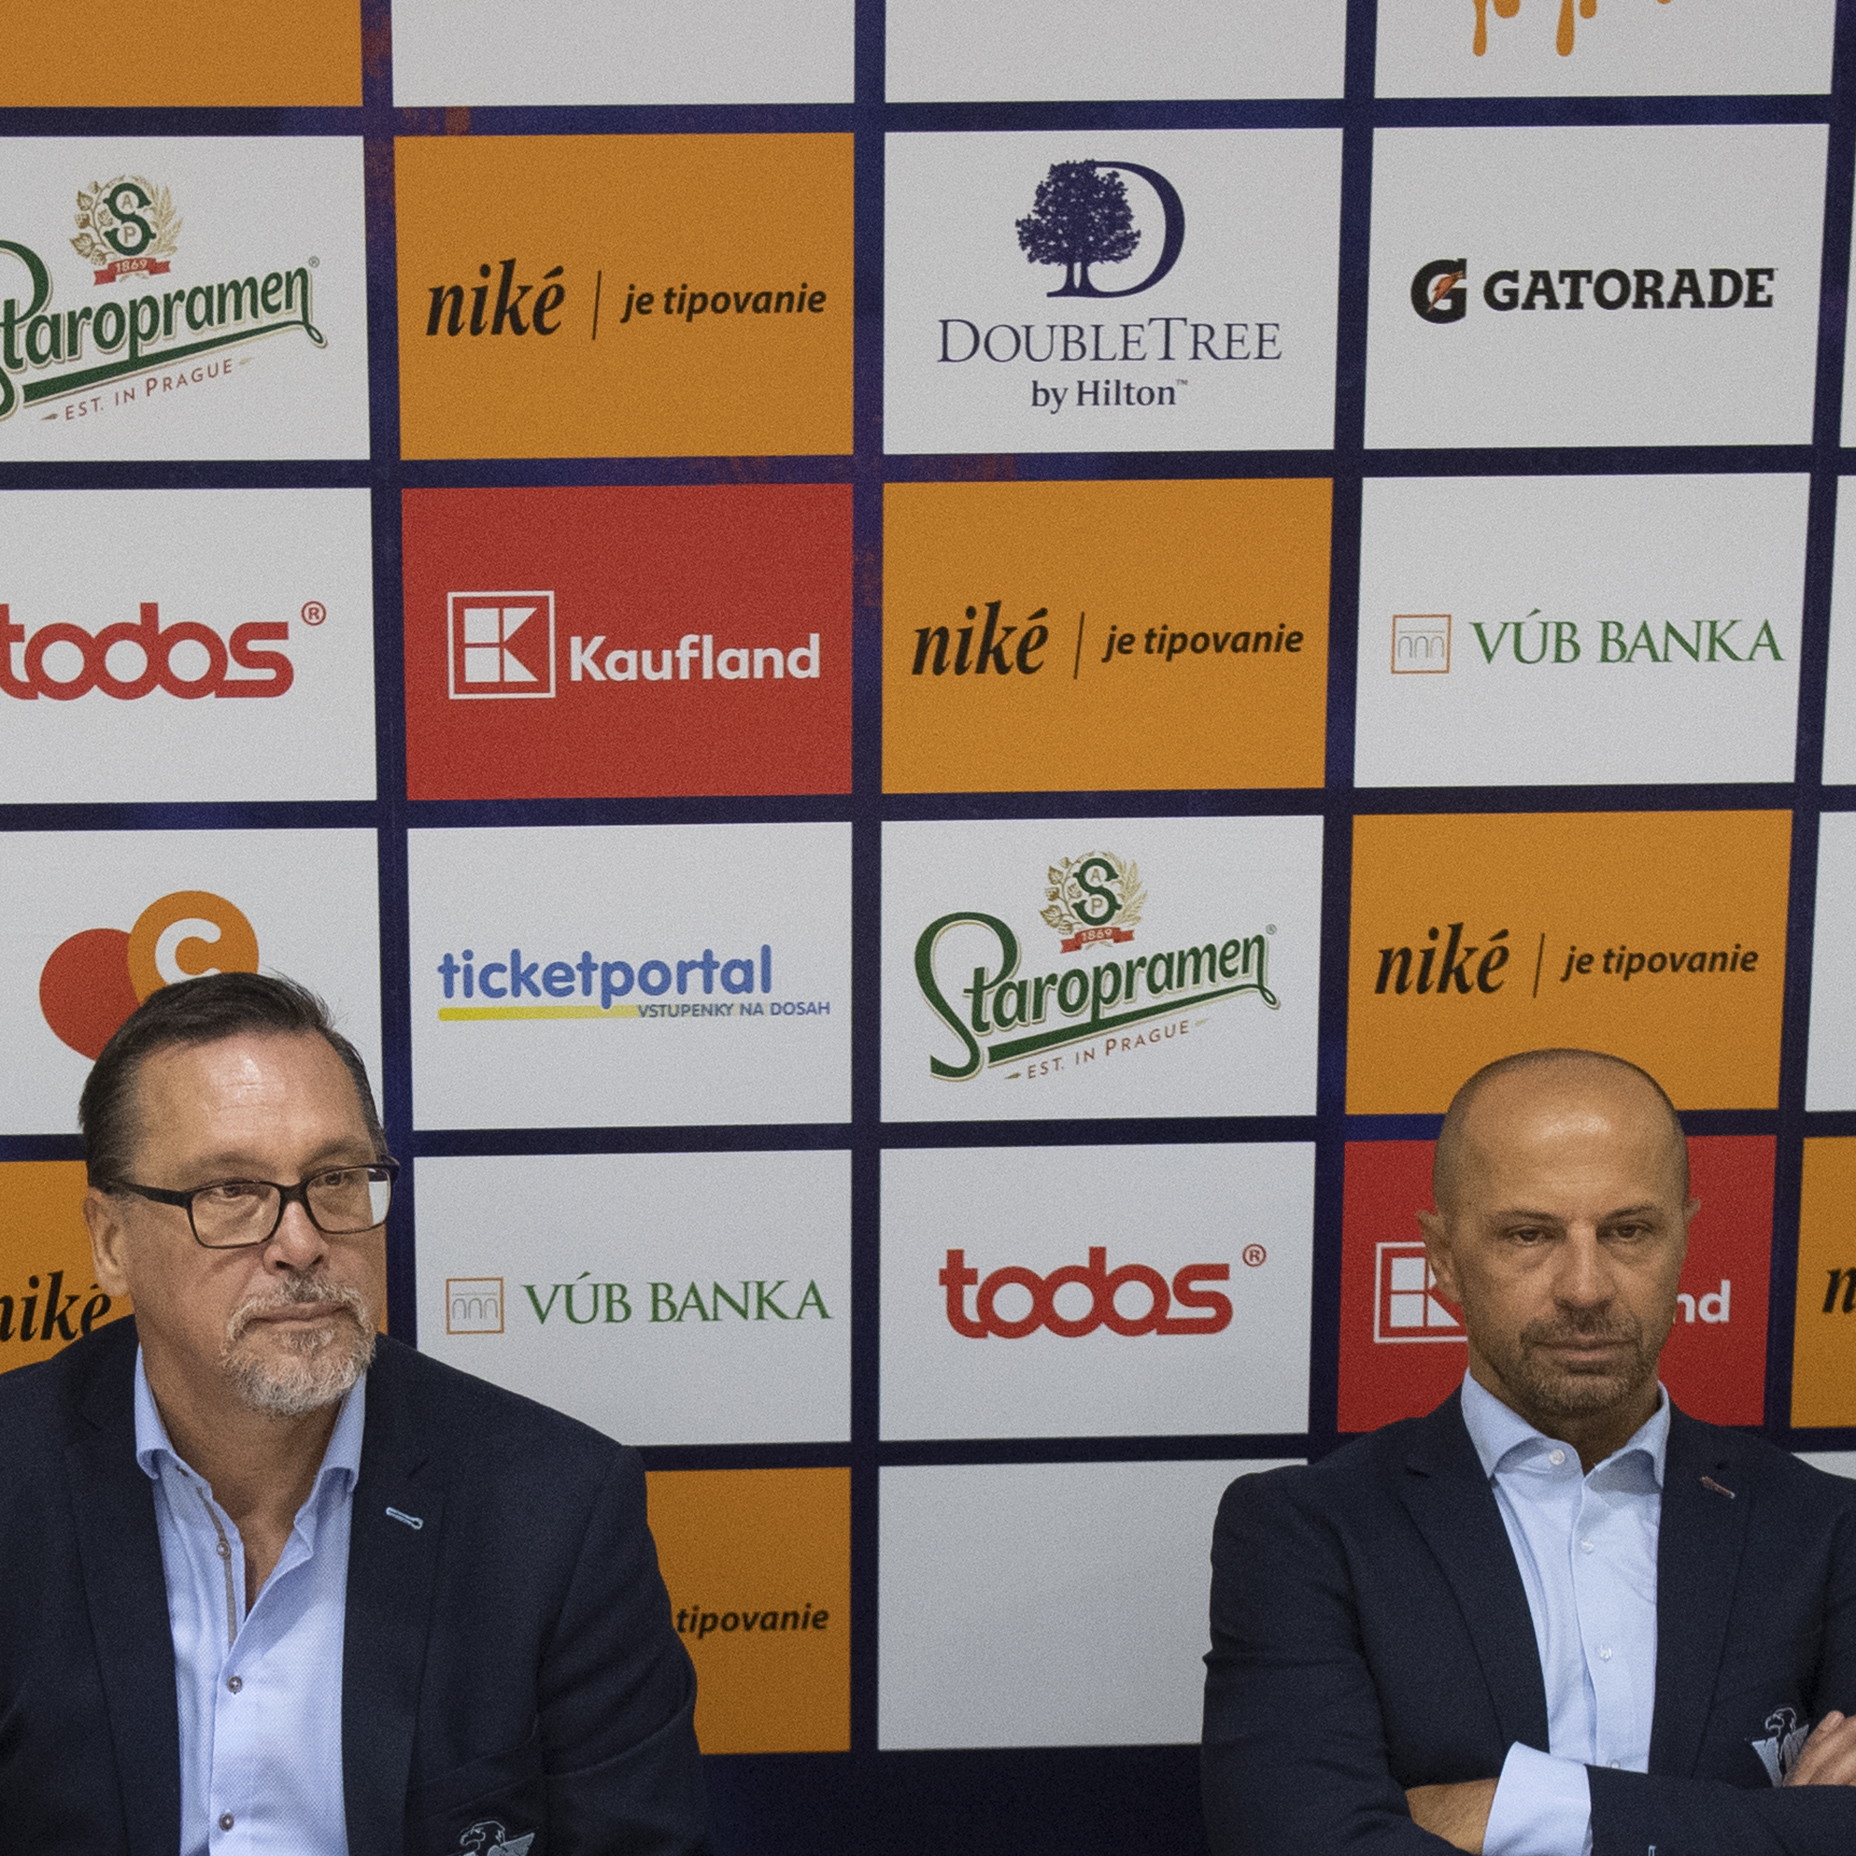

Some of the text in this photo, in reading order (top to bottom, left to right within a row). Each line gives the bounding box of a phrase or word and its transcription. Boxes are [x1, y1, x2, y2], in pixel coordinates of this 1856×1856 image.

[427, 258, 826, 336] niké je tipovanie
[1483, 268, 1774, 311] GATORADE
[114, 384, 139, 409] IN
[1032, 379, 1175, 414] by Hilton
[570, 633, 820, 681] Kaufland
[912, 601, 1303, 676] niké je tipovanie
[1472, 609, 1783, 664] VÚB BANKA
[437, 944, 773, 1010] ticketportal
[1375, 923, 1758, 995] niké je tipovanie
[637, 1000, 831, 1019] VSTUPENKY NA DOSAH
[912, 912, 1283, 1083] Staropramen
[1074, 1047, 1097, 1069] IN
[524, 1272, 830, 1324] VÚB BANKA
[939, 1247, 1233, 1339] todos
[674, 1601, 829, 1640] tipovanie
